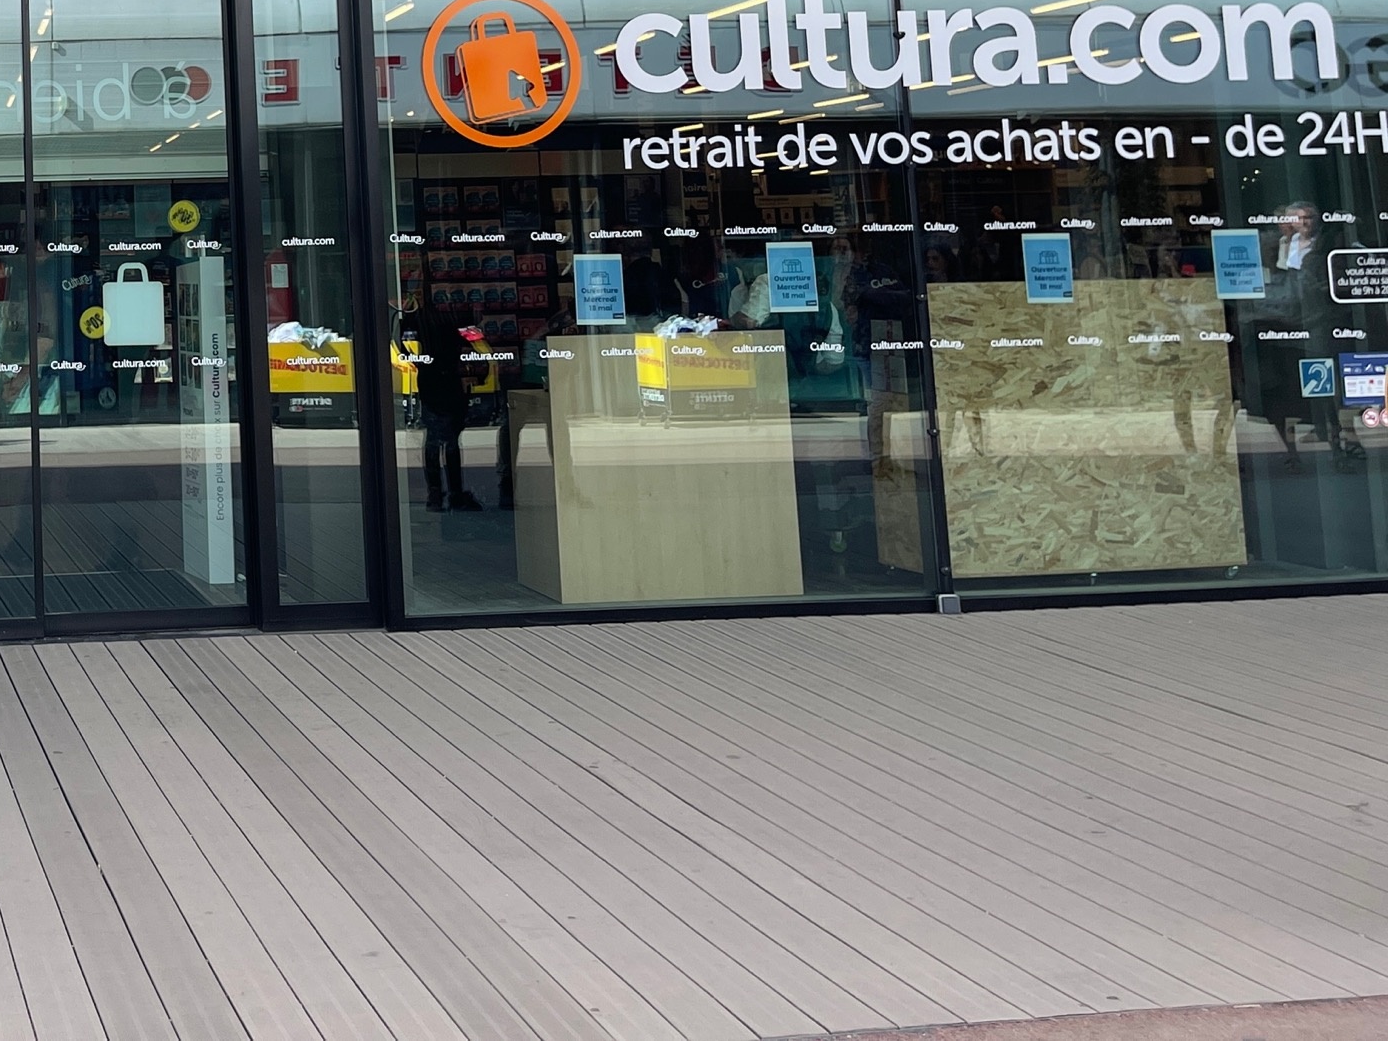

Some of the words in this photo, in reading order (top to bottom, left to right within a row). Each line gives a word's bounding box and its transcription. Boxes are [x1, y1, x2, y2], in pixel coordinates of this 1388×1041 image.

[622, 124, 764, 170] retrait
[778, 123, 838, 167] de
[849, 129, 933, 165] vos
[947, 119, 1101, 162] achats
[1115, 126, 1175, 160] en
[1191, 136, 1210, 144] -
[1225, 114, 1285, 157] de
[1297, 111, 1388, 155] 24H
[389, 233, 426, 245] Cultura
[451, 232, 505, 244] cultura.com
[530, 231, 567, 243] Cultura
[589, 229, 643, 240] cultura.com
[664, 227, 700, 238] Cultura
[724, 225, 777, 236] cultura.com
[802, 223, 837, 235] Cultura
[862, 222, 914, 233] cultura.com
[924, 222, 959, 234] Cultura
[984, 220, 1036, 231] cultura.com
[1060, 218, 1096, 230] Cultura
[1120, 216, 1173, 227] cultura.com
[1189, 214, 1224, 226] Cultura
[1322, 212, 1356, 224] Cultura
[47, 242, 82, 254] Cultura
[108, 241, 162, 252] cultura.com
[186, 239, 222, 250] Cultura
[281, 236, 335, 247] cultura.com
[460, 350, 514, 361] cultura.com
[539, 349, 575, 360] Cultura
[671, 345, 707, 356] Cultura
[732, 343, 785, 354] cultura.com
[810, 341, 845, 353] Cultura
[870, 339, 924, 350] cultura.com
[930, 339, 965, 350] Cultura
[990, 337, 1044, 348] cultura.com
[1067, 335, 1103, 347] Cultura
[1128, 333, 1180, 344] cultura.com
[1199, 331, 1234, 343] Cultura
[1258, 330, 1310, 341] cultura.com
[1332, 328, 1367, 340] Cultura
[50, 360, 86, 372] Cultura
[112, 358, 166, 369] cultura.com
[191, 356, 227, 368] Cultura
[212, 333, 220, 399] Cultur.com
[286, 355, 340, 366] cultura.com
[216, 486, 224, 521] Encore
